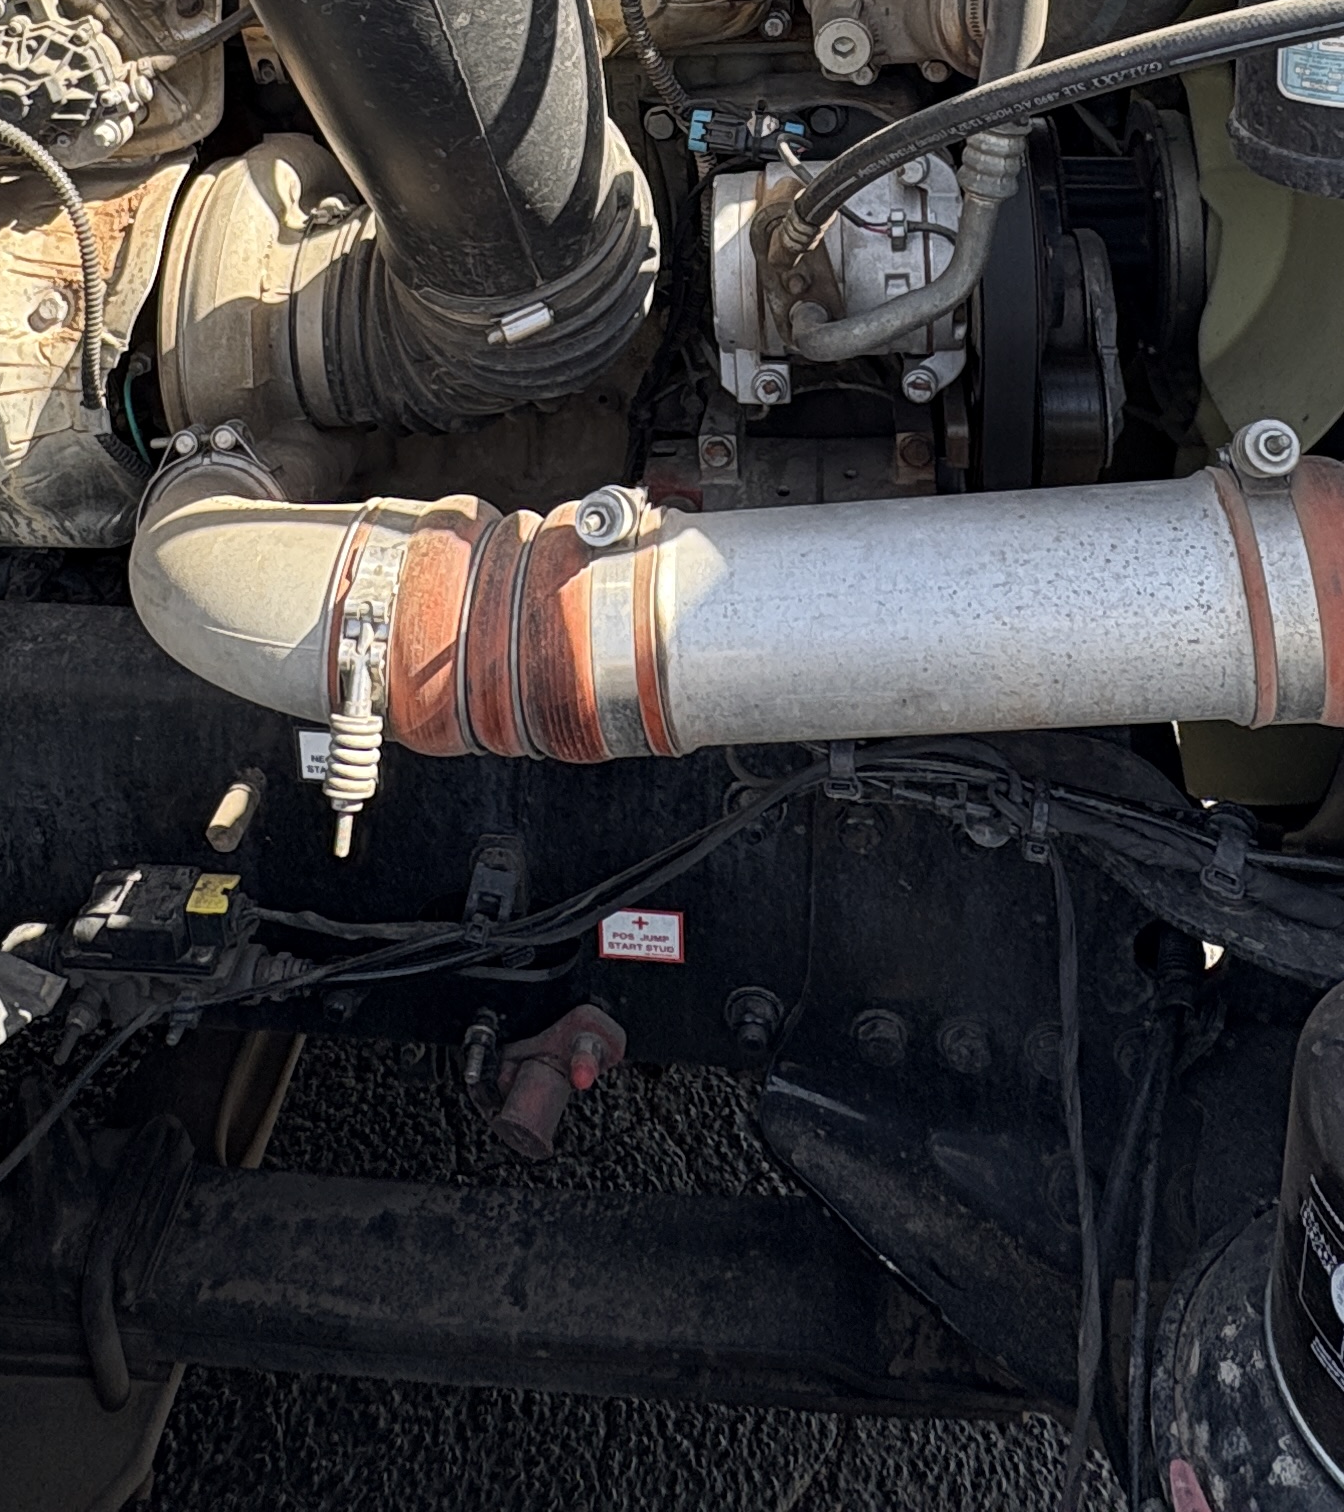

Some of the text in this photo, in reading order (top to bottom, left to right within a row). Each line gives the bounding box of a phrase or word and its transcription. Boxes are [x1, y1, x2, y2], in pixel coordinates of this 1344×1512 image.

[1091, 61, 1163, 87] GALAXY
[310, 754, 327, 764] NE
[612, 931, 670, 943] POS JUMP
[608, 941, 675, 954] START STUD
